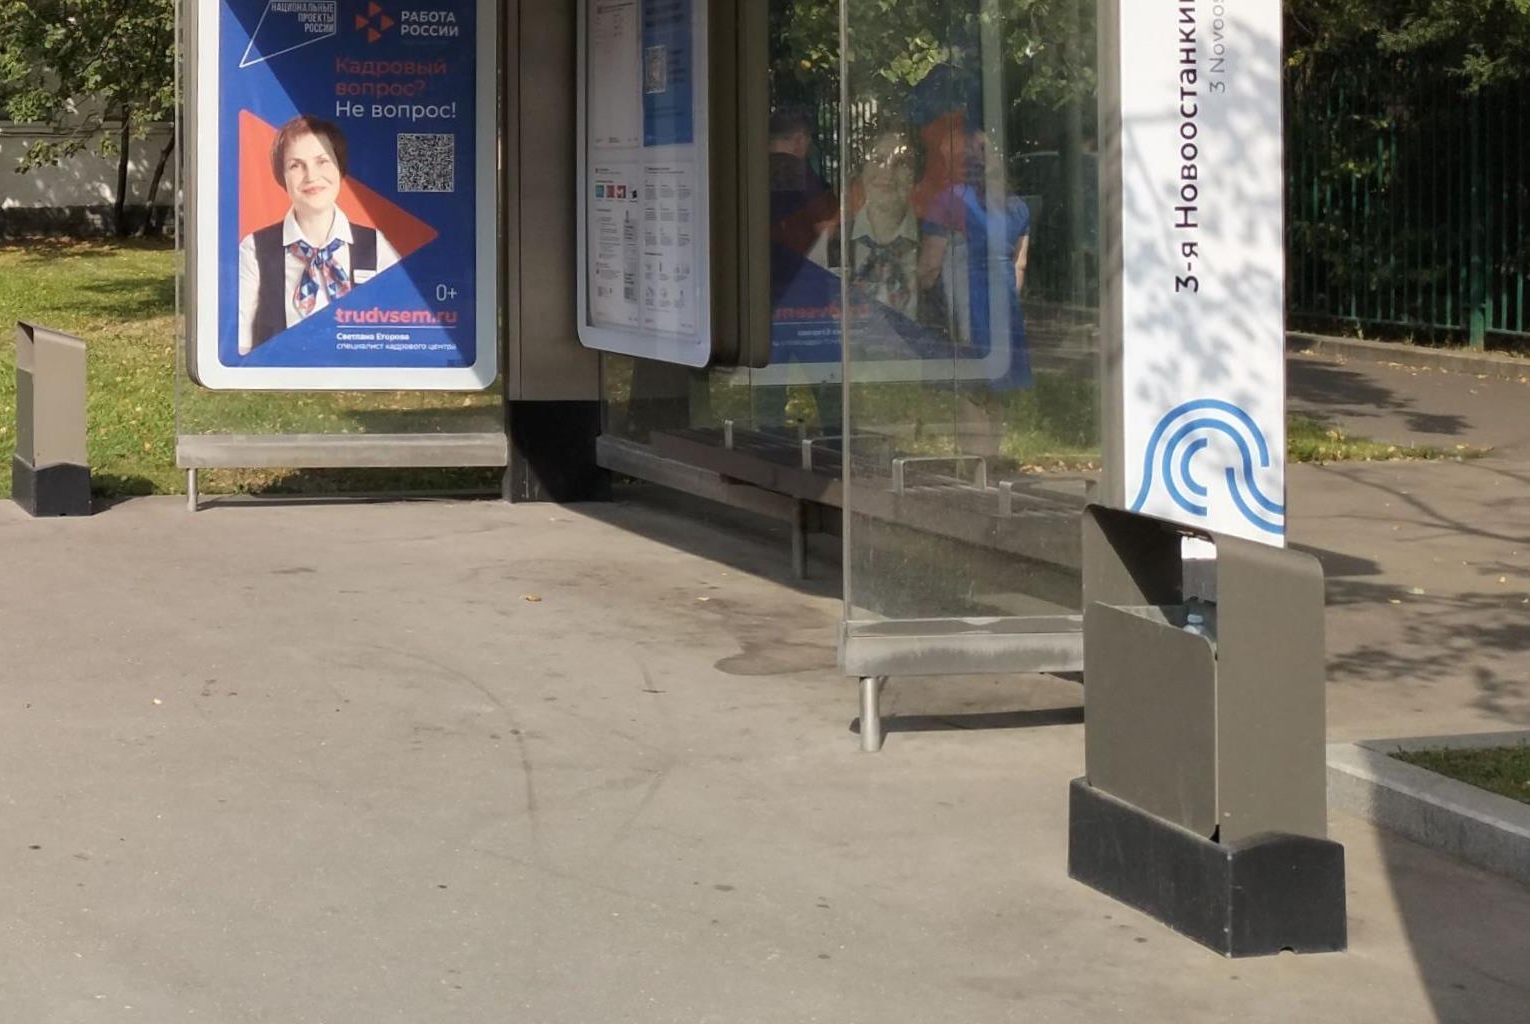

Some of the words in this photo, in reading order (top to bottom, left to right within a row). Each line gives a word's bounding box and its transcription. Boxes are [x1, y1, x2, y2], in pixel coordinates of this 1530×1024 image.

[271, 2, 335, 12] НАЦИОНАЛЬНЫЕ
[298, 12, 335, 23] ПРОЕКТЫ
[401, 11, 456, 23] РАБОТА
[304, 22, 335, 33] РОССИИ
[401, 24, 459, 37] РОССИИ
[335, 56, 447, 76] Кадровый
[335, 80, 426, 99] вопрос?
[1209, 80, 1226, 93] 3
[336, 100, 365, 118] Не
[371, 101, 457, 123] вопрос!
[1175, 241, 1198, 293] 3-я
[436, 283, 458, 301] 0+
[335, 307, 458, 324] trudvsem.ru
[336, 332, 375, 341] Светлана
[376, 332, 410, 342] Егорова
[336, 343, 385, 351] специалист
